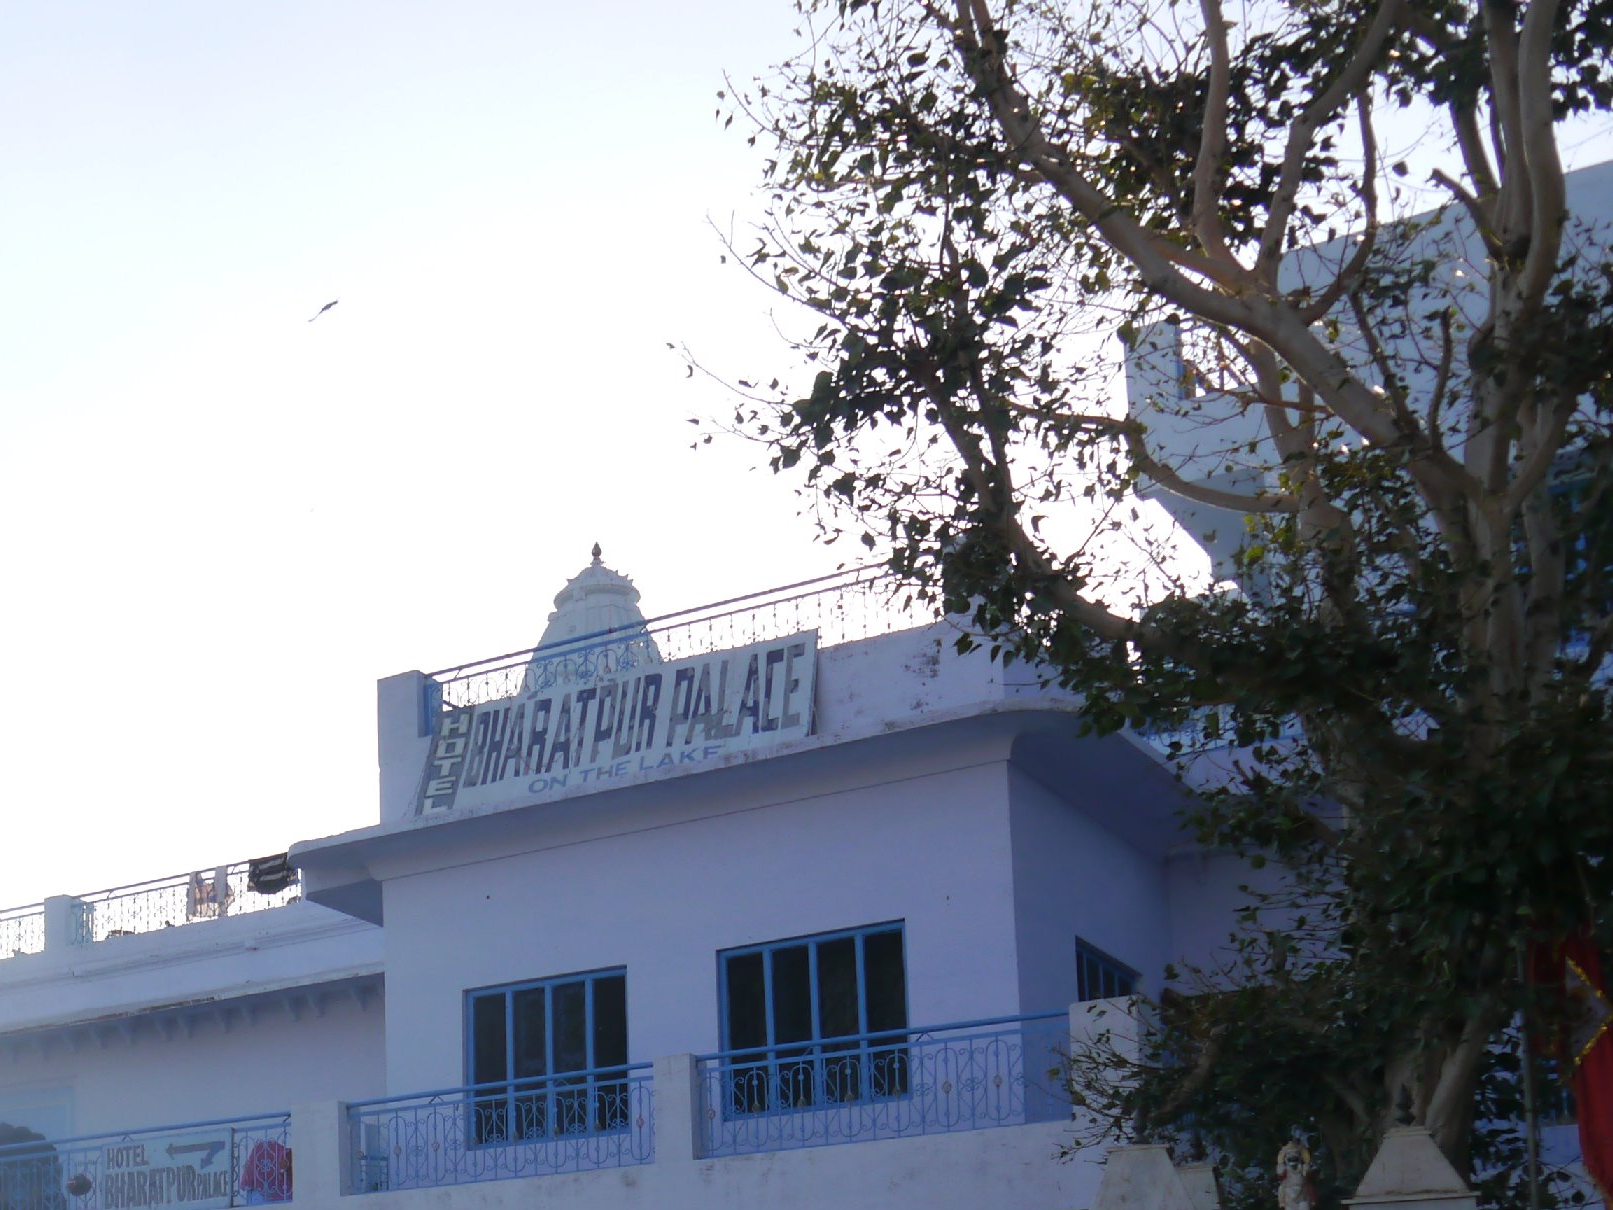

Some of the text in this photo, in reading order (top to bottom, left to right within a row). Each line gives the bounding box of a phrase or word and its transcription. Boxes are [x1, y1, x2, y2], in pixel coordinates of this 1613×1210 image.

[462, 643, 805, 788] BHARATPUR PALACE
[423, 715, 466, 813] HOTEL
[527, 743, 724, 795] ON THE LAKE
[106, 1143, 149, 1171] HOTEL
[103, 1164, 229, 1210] BHARATPUR PALACE
